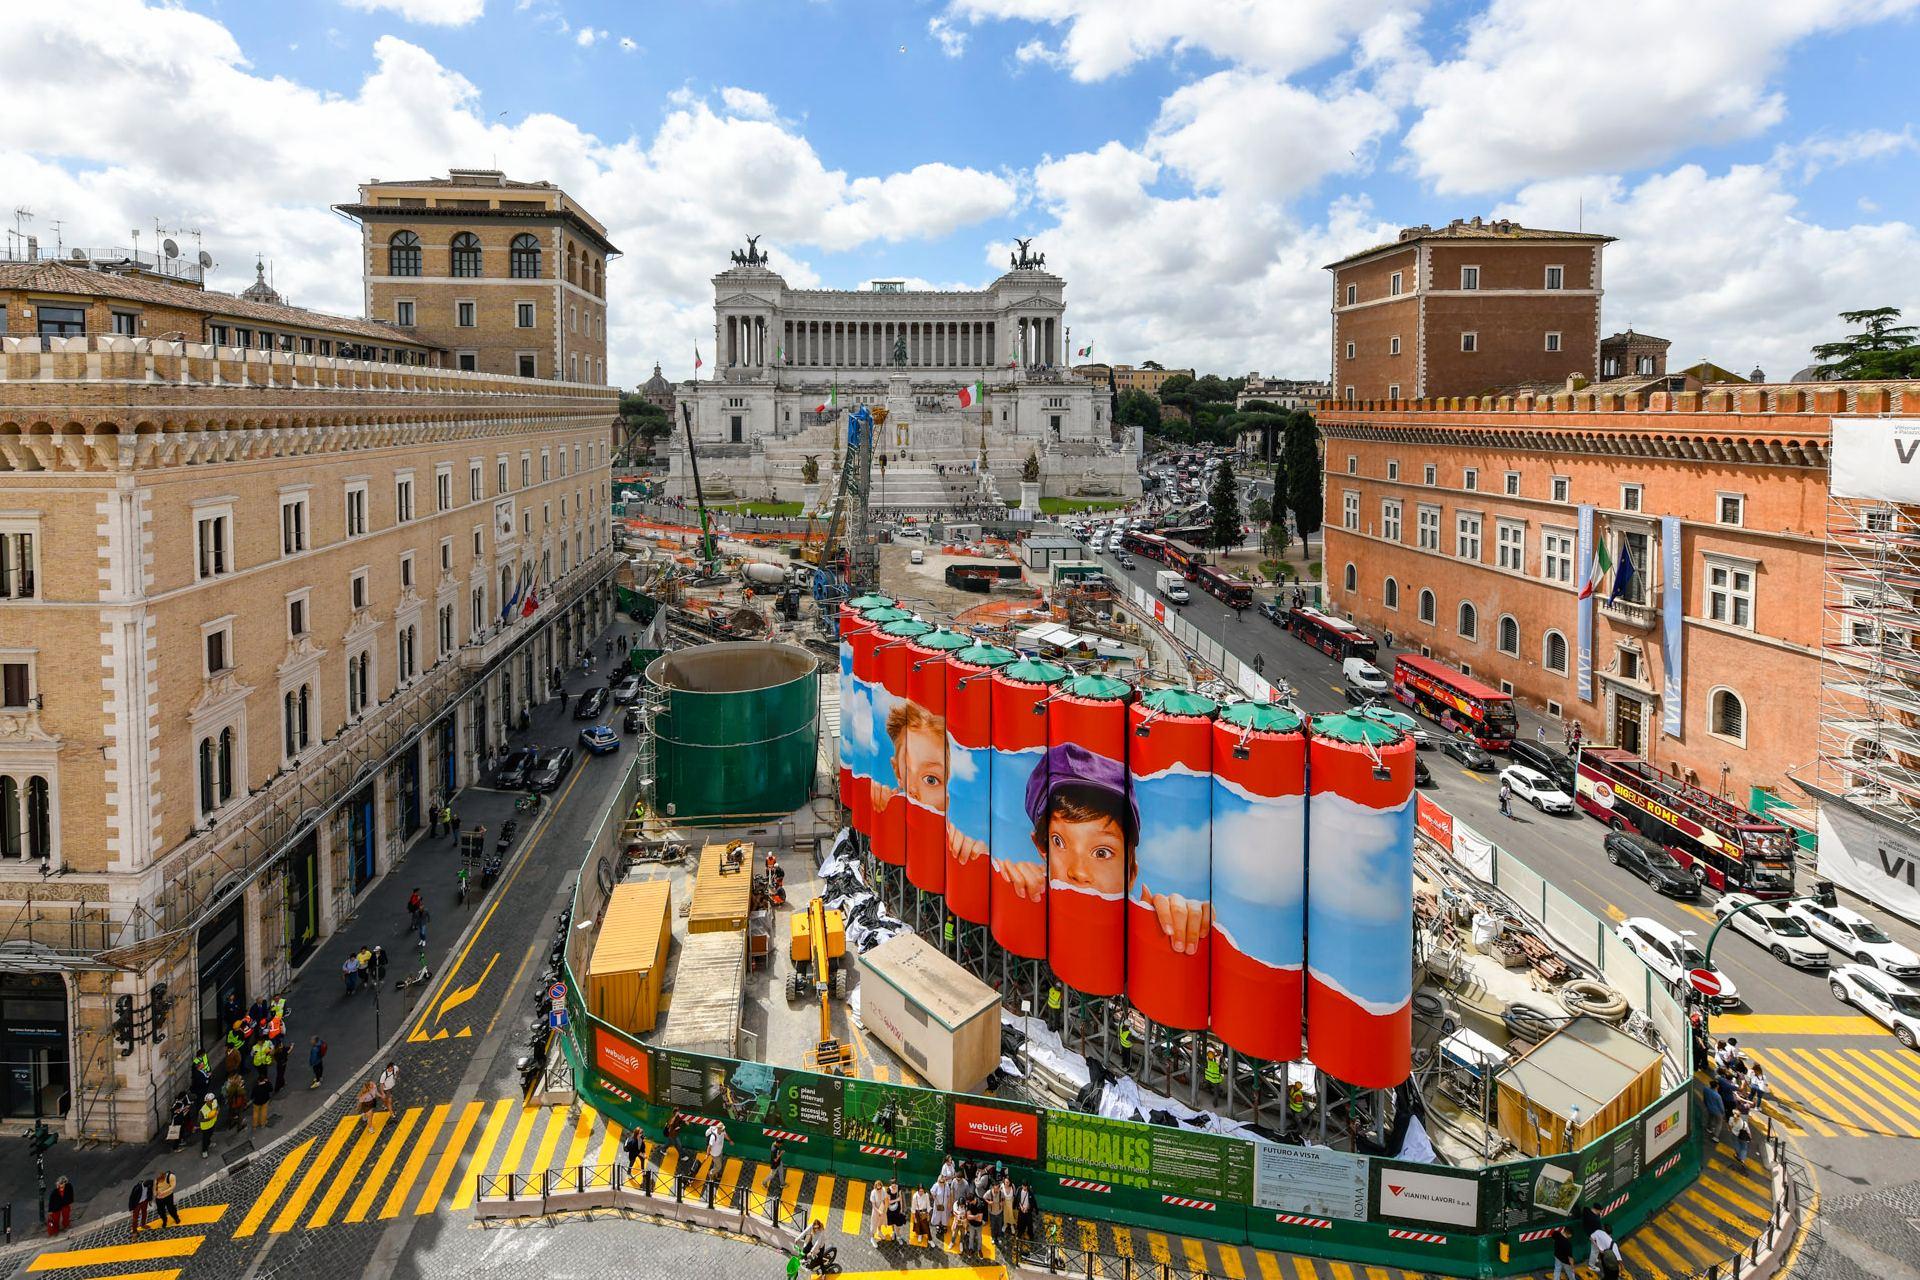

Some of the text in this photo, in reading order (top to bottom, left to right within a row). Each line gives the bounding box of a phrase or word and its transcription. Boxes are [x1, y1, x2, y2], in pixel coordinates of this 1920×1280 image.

[1578, 647, 1591, 690] VIVE
[1664, 674, 1680, 723] VIVE
[1647, 801, 1678, 826] ROME
[1878, 848, 1915, 887] VI
[605, 1047, 630, 1065] webuild
[789, 1086, 799, 1100] 6
[801, 1094, 824, 1103] interrati
[789, 1104, 798, 1117] 3
[801, 1113, 828, 1122] superficie
[833, 1107, 842, 1136] ROMA
[969, 1122, 1007, 1134] webuild
[1655, 1111, 1679, 1138] ROMA
[935, 1122, 943, 1151] ROMA
[1047, 1124, 1149, 1169] MURALES
[1061, 1154, 1118, 1170] contemporanea
[1130, 1165, 1149, 1174] metro
[1263, 1147, 1292, 1156] FUTURO
[1300, 1152, 1320, 1160] VISTA
[1354, 1188, 1364, 1218] ROMA
[1404, 1192, 1429, 1200] VIANINI
[1431, 1196, 1455, 1204] LAVORI
